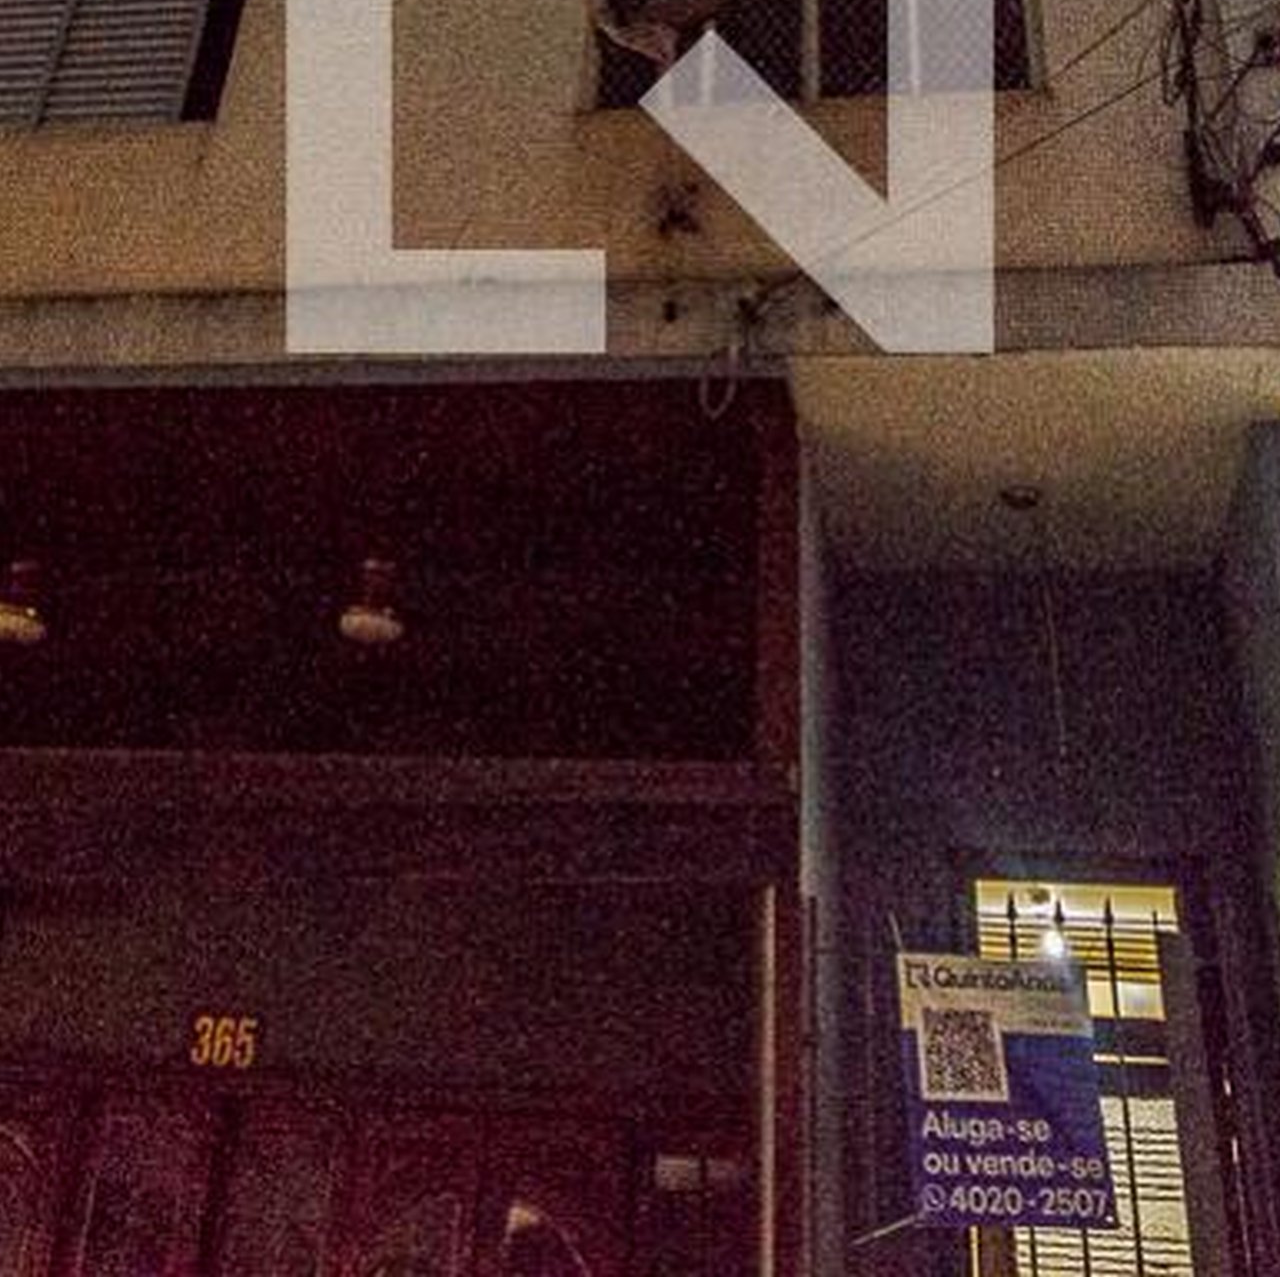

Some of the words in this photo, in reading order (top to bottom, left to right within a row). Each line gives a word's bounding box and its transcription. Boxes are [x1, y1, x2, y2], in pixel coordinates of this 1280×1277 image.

[933, 965, 1071, 992] QuintoAnd
[191, 1016, 258, 1068] 365
[923, 1110, 1051, 1146] Aluga-se
[923, 1152, 959, 1174] ou
[965, 1149, 1104, 1179] vende-se
[949, 1185, 1108, 1217] 4020-2507
